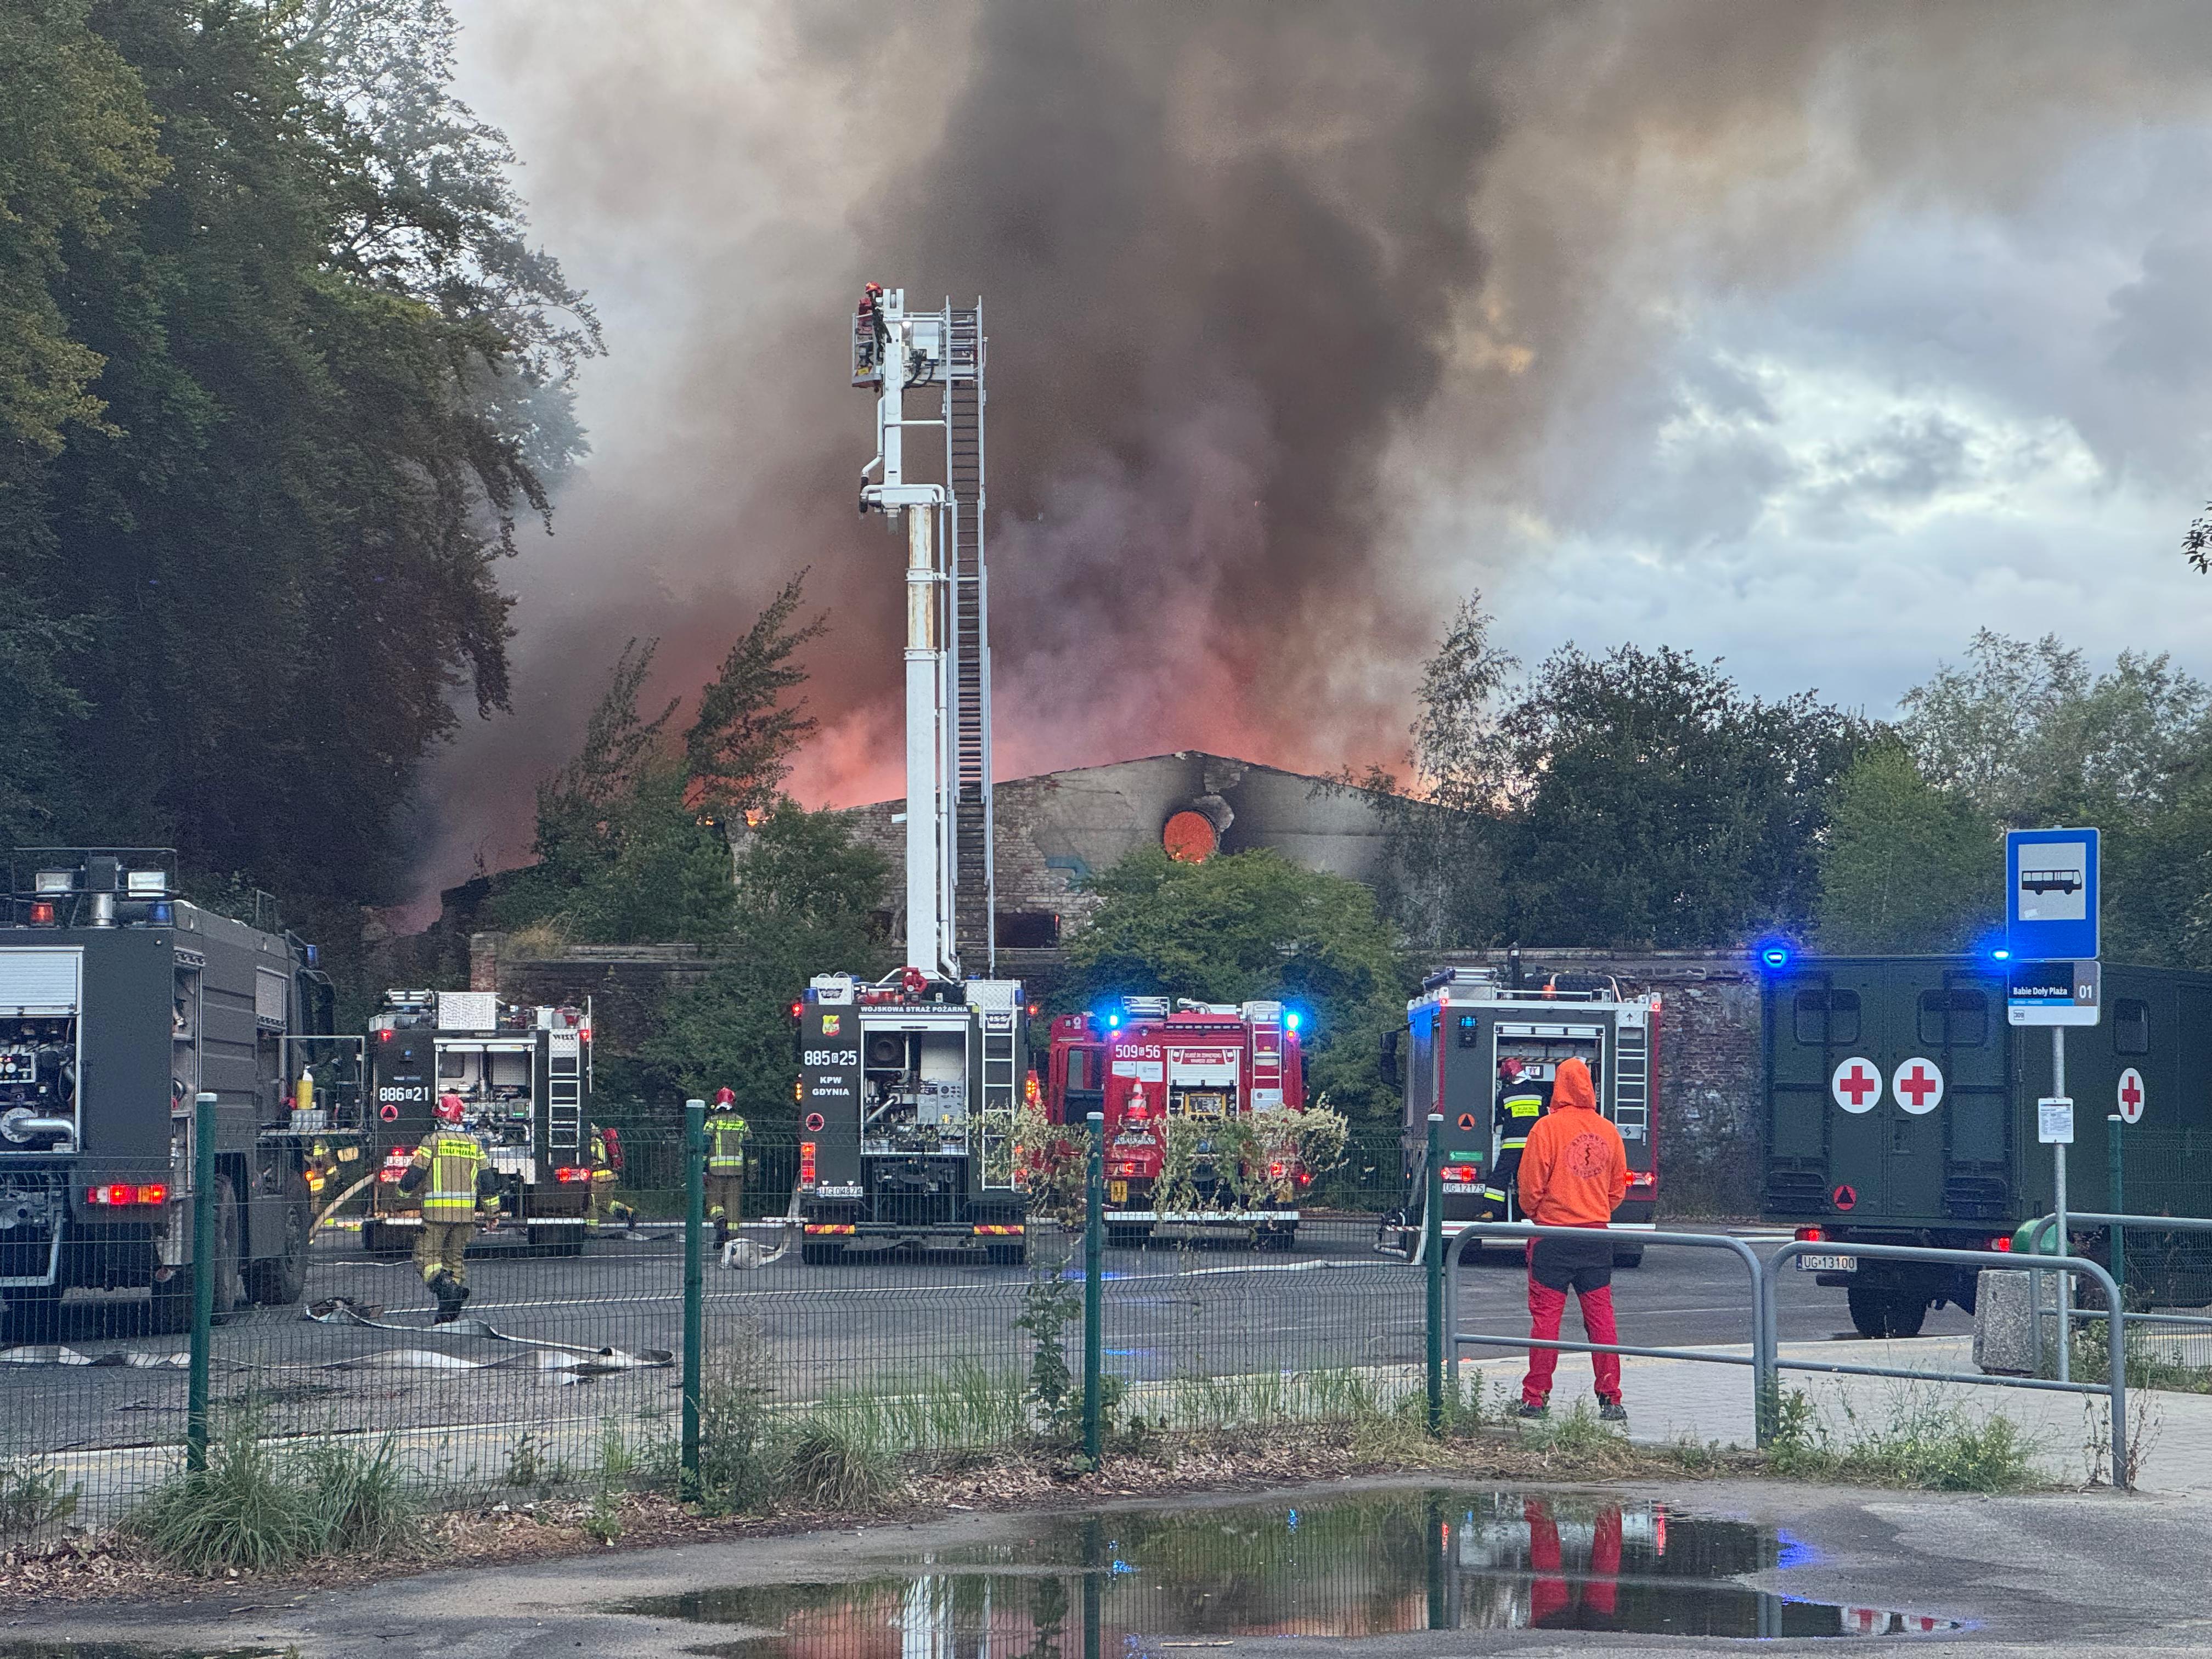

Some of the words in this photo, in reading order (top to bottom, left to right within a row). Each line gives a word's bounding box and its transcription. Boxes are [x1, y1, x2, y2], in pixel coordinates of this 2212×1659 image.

[2013, 986, 2032, 995] Babie
[2033, 986, 2049, 997] Doły
[2049, 986, 2068, 995] Plaża
[2079, 985, 2092, 999] 01
[1459, 1184, 1484, 1193] 12175
[1804, 1256, 1818, 1268] UG
[1822, 1257, 1855, 1269] 13100
